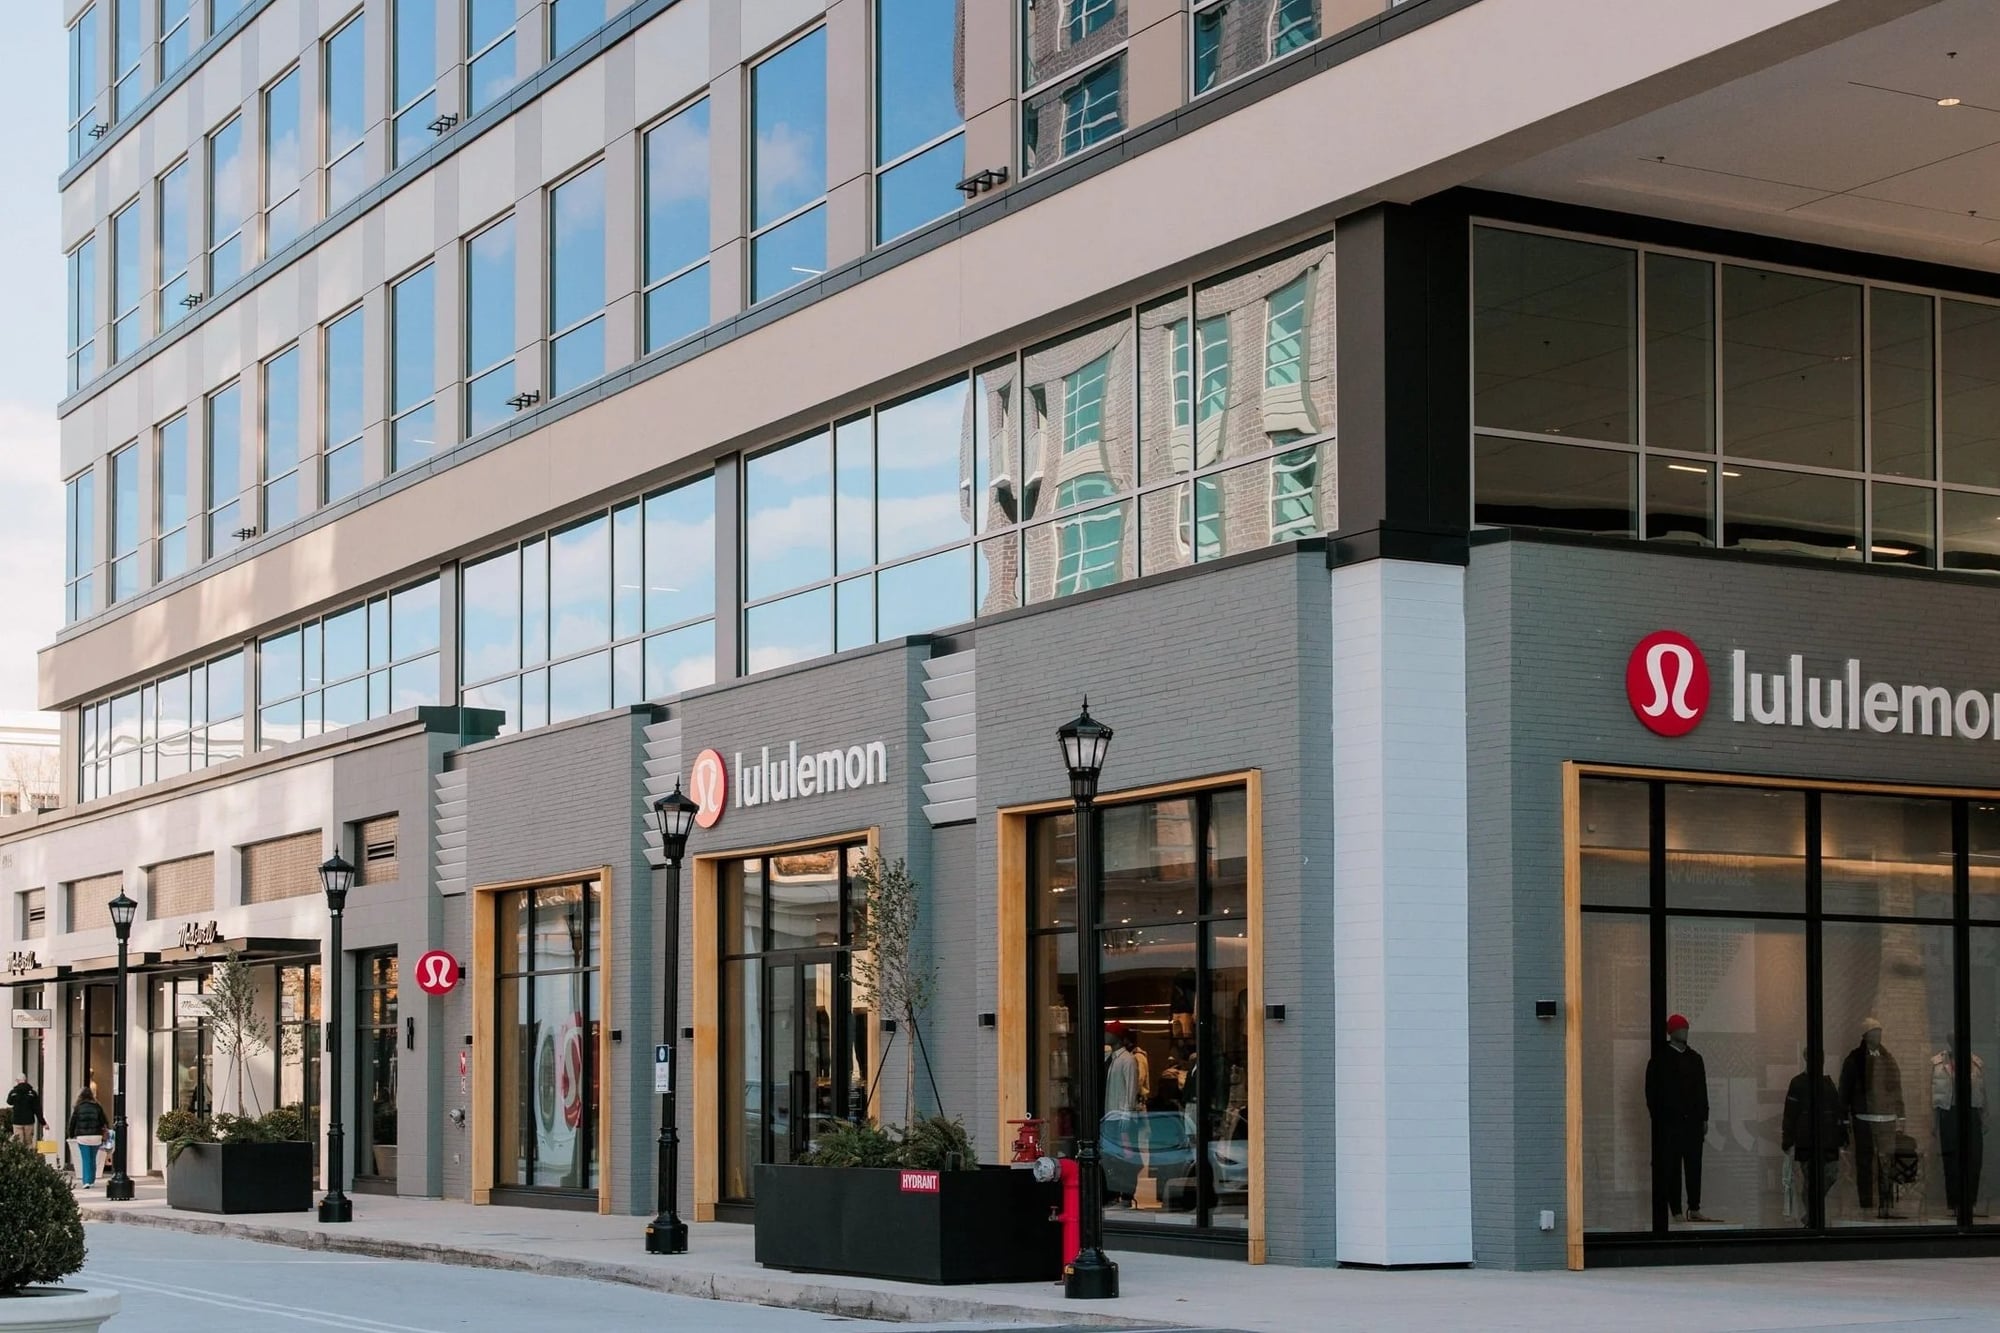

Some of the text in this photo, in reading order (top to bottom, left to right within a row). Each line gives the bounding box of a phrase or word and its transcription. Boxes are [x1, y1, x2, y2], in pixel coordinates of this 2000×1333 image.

[1733, 649, 2000, 740] lululemo
[735, 740, 887, 808] lululemon
[902, 1174, 937, 1189] HYDRANT
